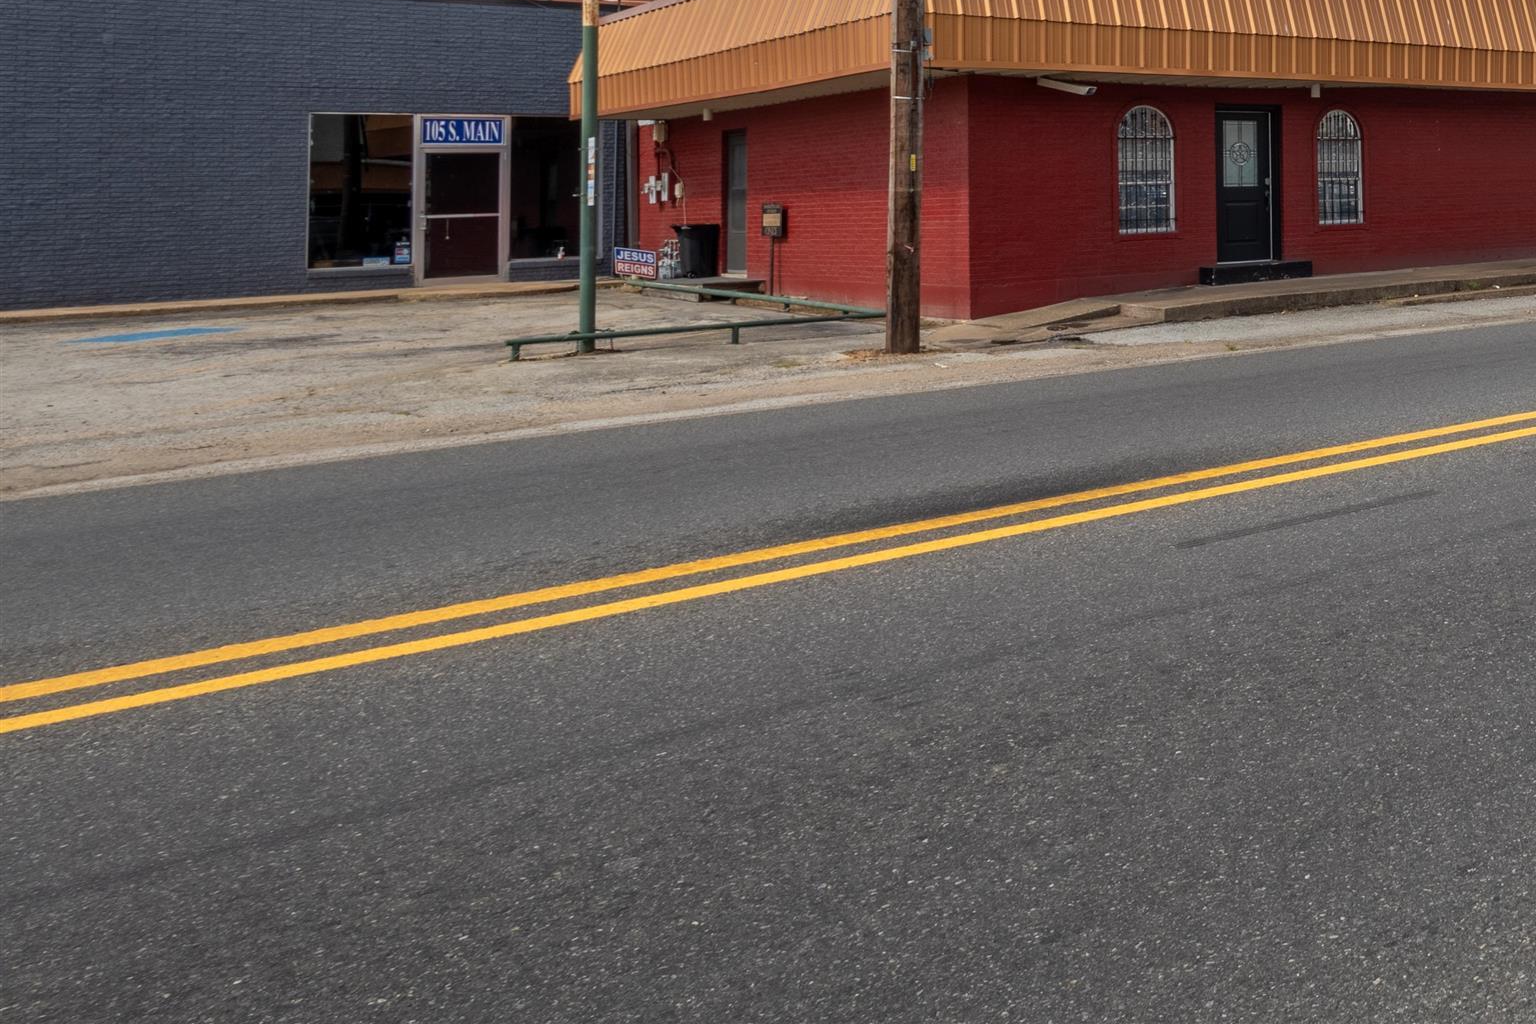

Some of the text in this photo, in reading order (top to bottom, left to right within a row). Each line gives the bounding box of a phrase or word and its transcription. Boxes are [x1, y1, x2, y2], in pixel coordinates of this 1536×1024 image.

[425, 120, 500, 141] 105 S. MAIN
[617, 250, 654, 263] JESUS
[617, 262, 654, 276] REIGNS
